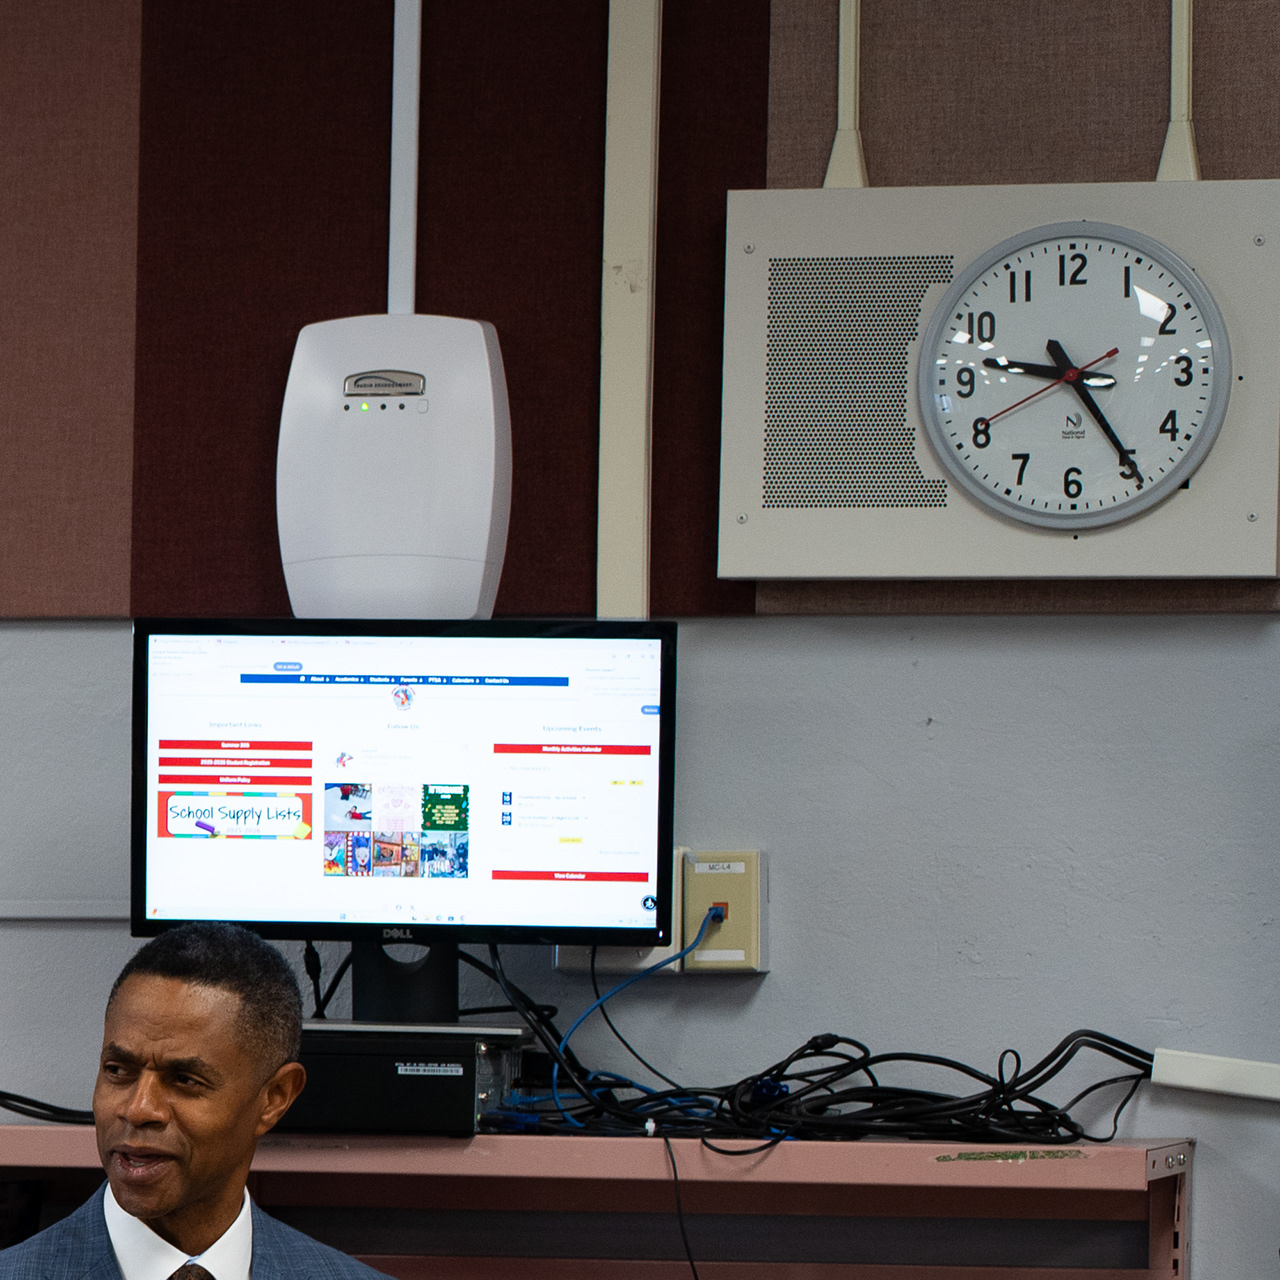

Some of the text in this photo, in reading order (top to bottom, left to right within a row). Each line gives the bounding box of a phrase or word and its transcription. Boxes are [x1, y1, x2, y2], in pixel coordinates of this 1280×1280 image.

[1058, 253, 1088, 286] 12
[1123, 266, 1130, 298] 1
[1009, 271, 1031, 303] 11
[967, 311, 996, 344] 10
[1158, 303, 1178, 335] 2
[956, 367, 976, 398] 9
[1174, 357, 1194, 387] 3
[972, 417, 992, 448] 8
[1159, 410, 1179, 441] 4
[1011, 454, 1031, 485] 7
[1118, 449, 1137, 480] 5
[1063, 468, 1083, 498] 6
[542, 725, 578, 733] Upcoming
[169, 805, 301, 825] School Supply Lists
[382, 928, 413, 938] DELL
